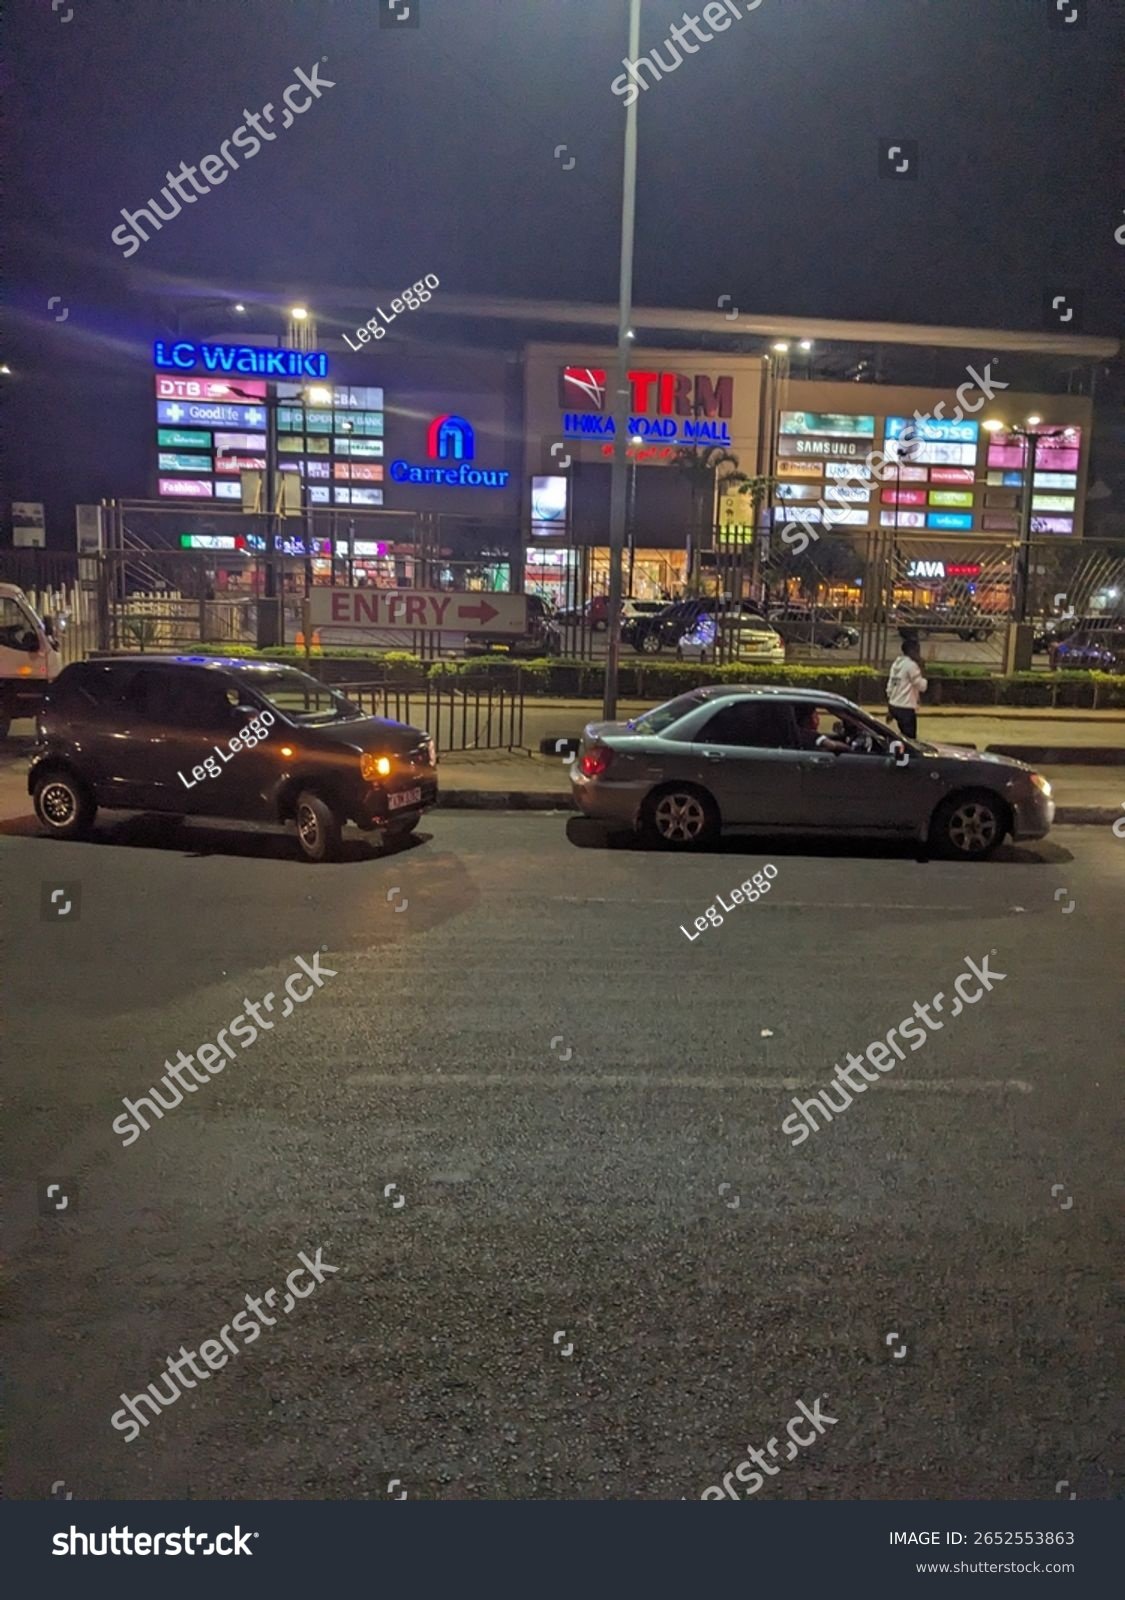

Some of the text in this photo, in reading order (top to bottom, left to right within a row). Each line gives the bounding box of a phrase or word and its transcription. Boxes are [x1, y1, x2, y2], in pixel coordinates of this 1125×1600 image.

[156, 342, 197, 369] LC
[160, 379, 201, 396] DTB
[628, 371, 733, 418] TRM
[684, 418, 732, 442] MALL
[796, 439, 857, 455] SAMSUNG
[390, 460, 511, 488] Carrefour
[907, 560, 945, 578] JAVA
[331, 592, 452, 626] ENTRY
